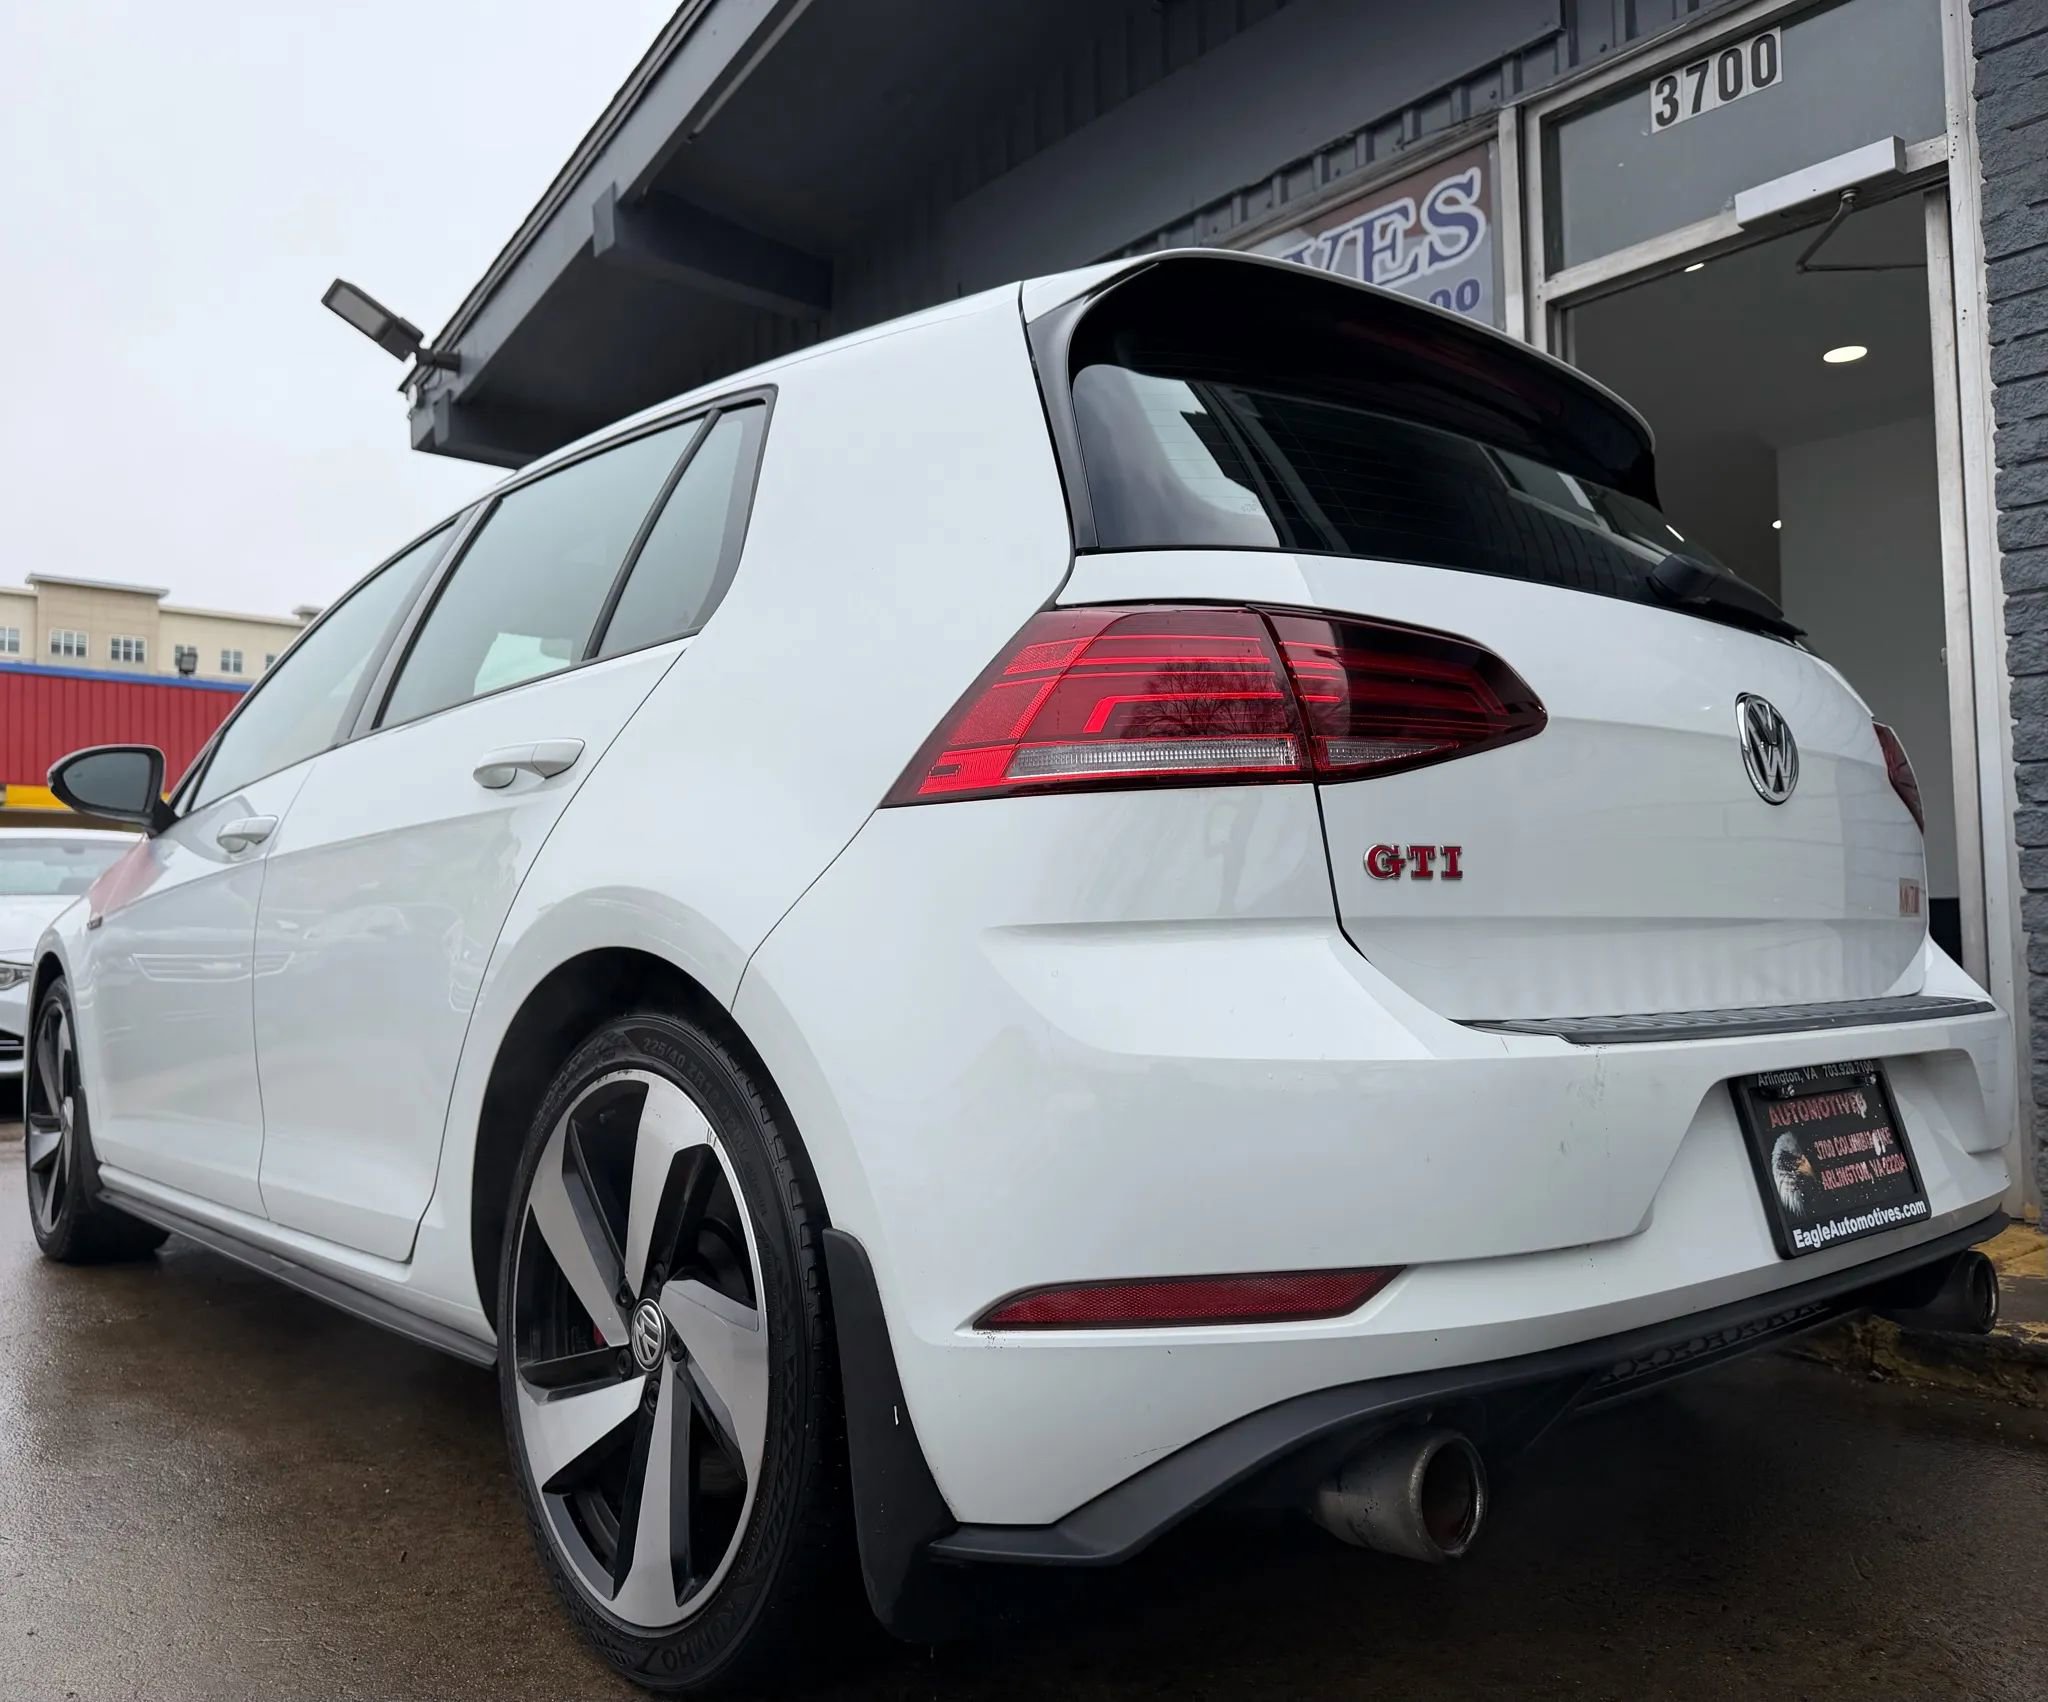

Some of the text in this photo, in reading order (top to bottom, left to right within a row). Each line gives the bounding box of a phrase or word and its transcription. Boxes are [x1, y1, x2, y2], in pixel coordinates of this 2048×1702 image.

[1655, 33, 1777, 127] 3700
[1363, 844, 1464, 880] GTI
[1758, 1069, 1804, 1087] Arlington,
[1803, 1067, 1818, 1081] VA
[1868, 1158, 1887, 1178] VA
[1793, 1199, 1927, 1248] EagleAutomotives.com
